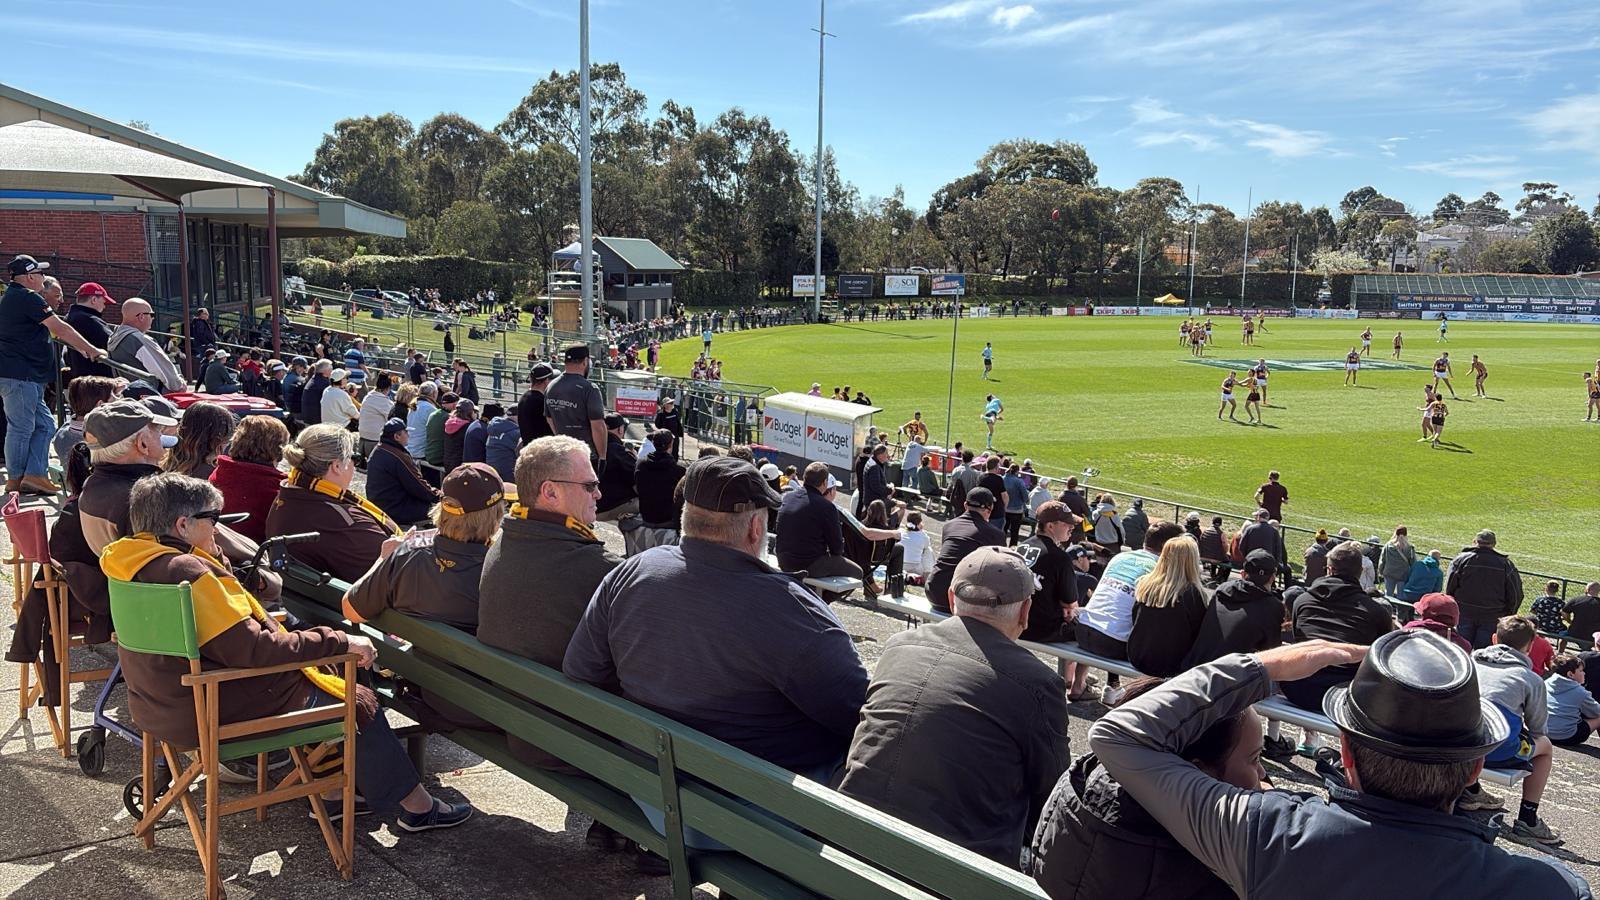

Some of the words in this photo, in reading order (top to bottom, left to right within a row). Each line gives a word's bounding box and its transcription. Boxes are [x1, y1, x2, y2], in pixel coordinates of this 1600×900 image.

[902, 278, 917, 287] SCM
[774, 418, 801, 438] Budget
[818, 428, 849, 449] Budget
